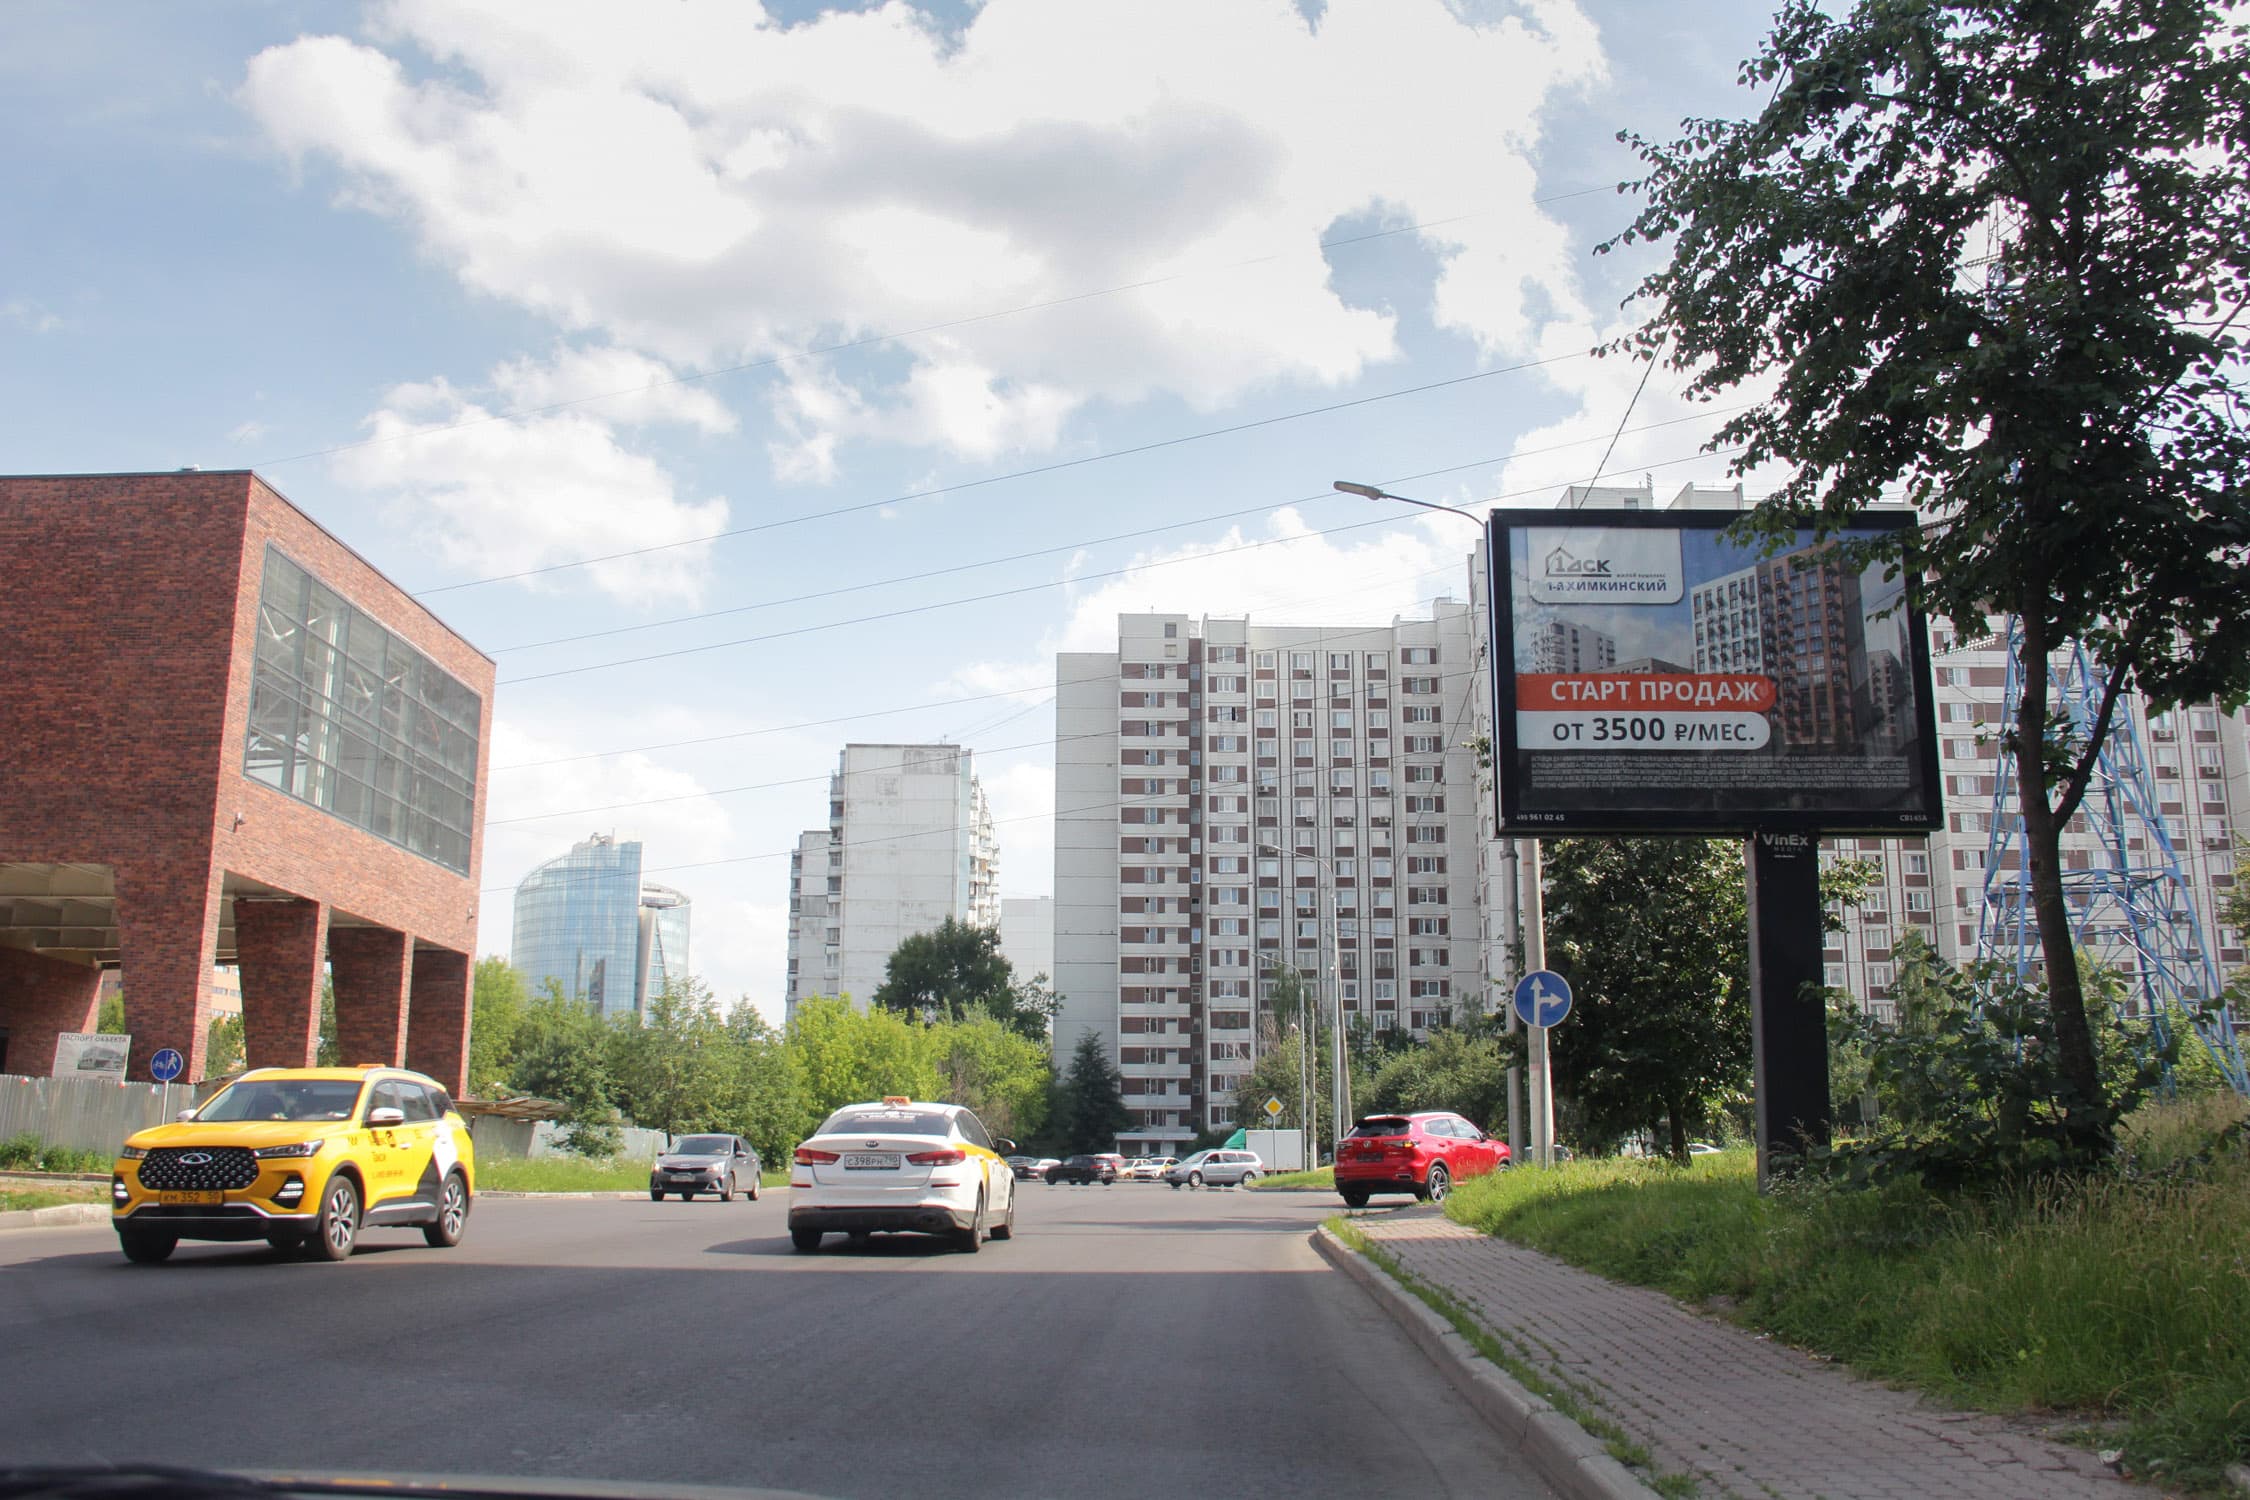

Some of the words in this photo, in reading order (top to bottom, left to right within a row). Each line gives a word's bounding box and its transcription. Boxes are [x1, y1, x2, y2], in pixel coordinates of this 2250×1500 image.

[1566, 579, 1667, 591] ХИМКИНСКИЙ
[1551, 681, 1631, 701] СТАРТ
[1640, 681, 1760, 706] ПРОДАЖ
[1552, 723, 1584, 741] ОТ
[1592, 717, 1665, 741] 3500
[1762, 834, 1808, 846] VinEx
